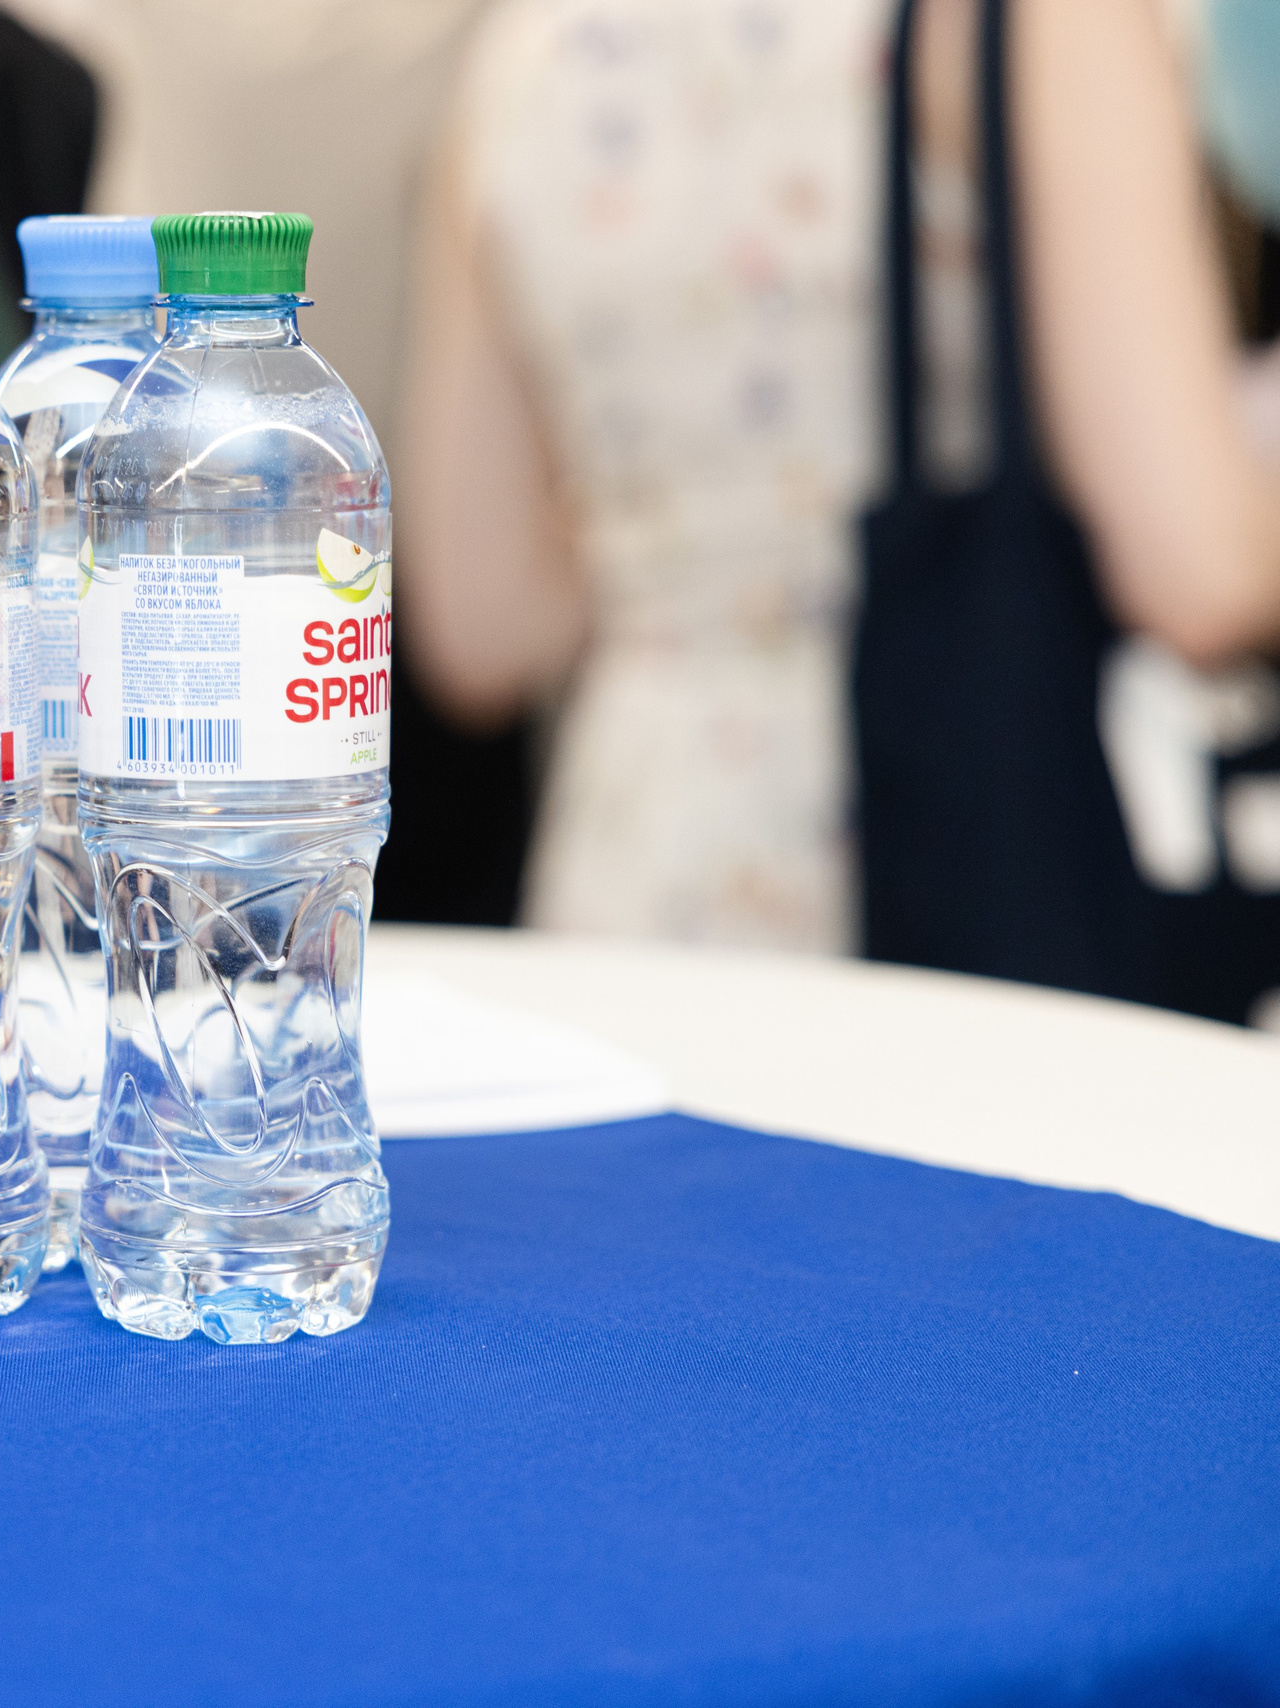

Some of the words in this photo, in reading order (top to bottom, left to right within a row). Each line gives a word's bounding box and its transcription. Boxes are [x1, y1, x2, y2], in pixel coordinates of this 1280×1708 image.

[120, 557, 153, 569] НАПИТОК
[138, 570, 217, 583] НЕГАЗИРОВАННЫЙ
[135, 597, 145, 609] СО
[148, 598, 182, 609] ВКУСОМ
[185, 599, 221, 610] ЯБЛОКА
[352, 730, 376, 745] STILL
[350, 748, 377, 765] APPLE
[116, 761, 122, 771] 4
[127, 761, 175, 774] 603934
[180, 764, 235, 775] 001011
